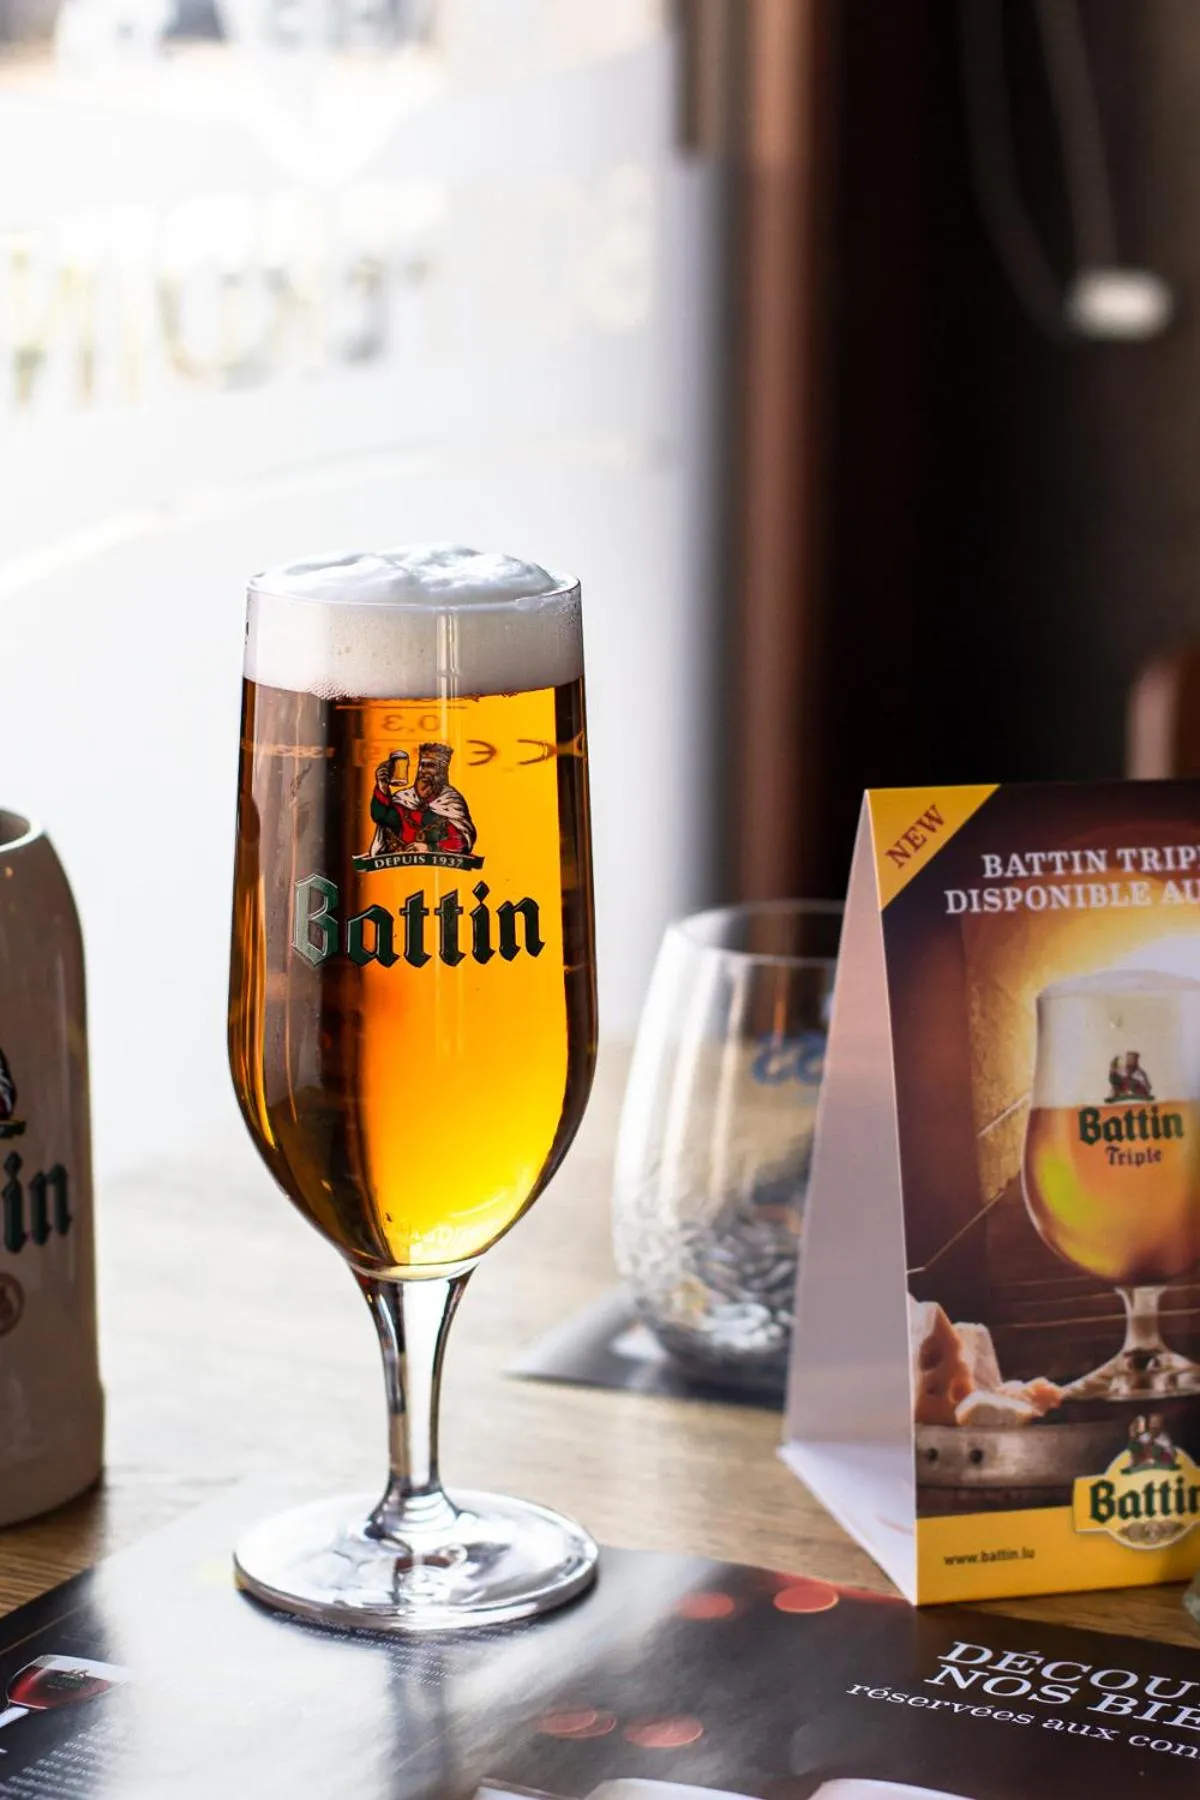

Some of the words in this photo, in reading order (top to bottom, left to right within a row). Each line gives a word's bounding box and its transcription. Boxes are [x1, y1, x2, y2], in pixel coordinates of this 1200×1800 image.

[884, 803, 945, 868] NEW
[373, 855, 426, 868] DEPUIS
[432, 856, 464, 868] 1937
[982, 851, 1108, 878] BATTIN
[1117, 845, 1200, 873] TRIP
[944, 881, 1152, 914] DISPONIBLE
[291, 873, 545, 968] Battin
[1079, 1105, 1184, 1146] Battin
[1105, 1146, 1162, 1168] Triple
[944, 1546, 1035, 1566] www.battin.lu
[923, 1664, 1080, 1704] NOS
[937, 1640, 1200, 1699] DÉCOU
[846, 1684, 1035, 1725] réservées
[1042, 1718, 1120, 1741] aux
[1128, 1734, 1200, 1760] con
